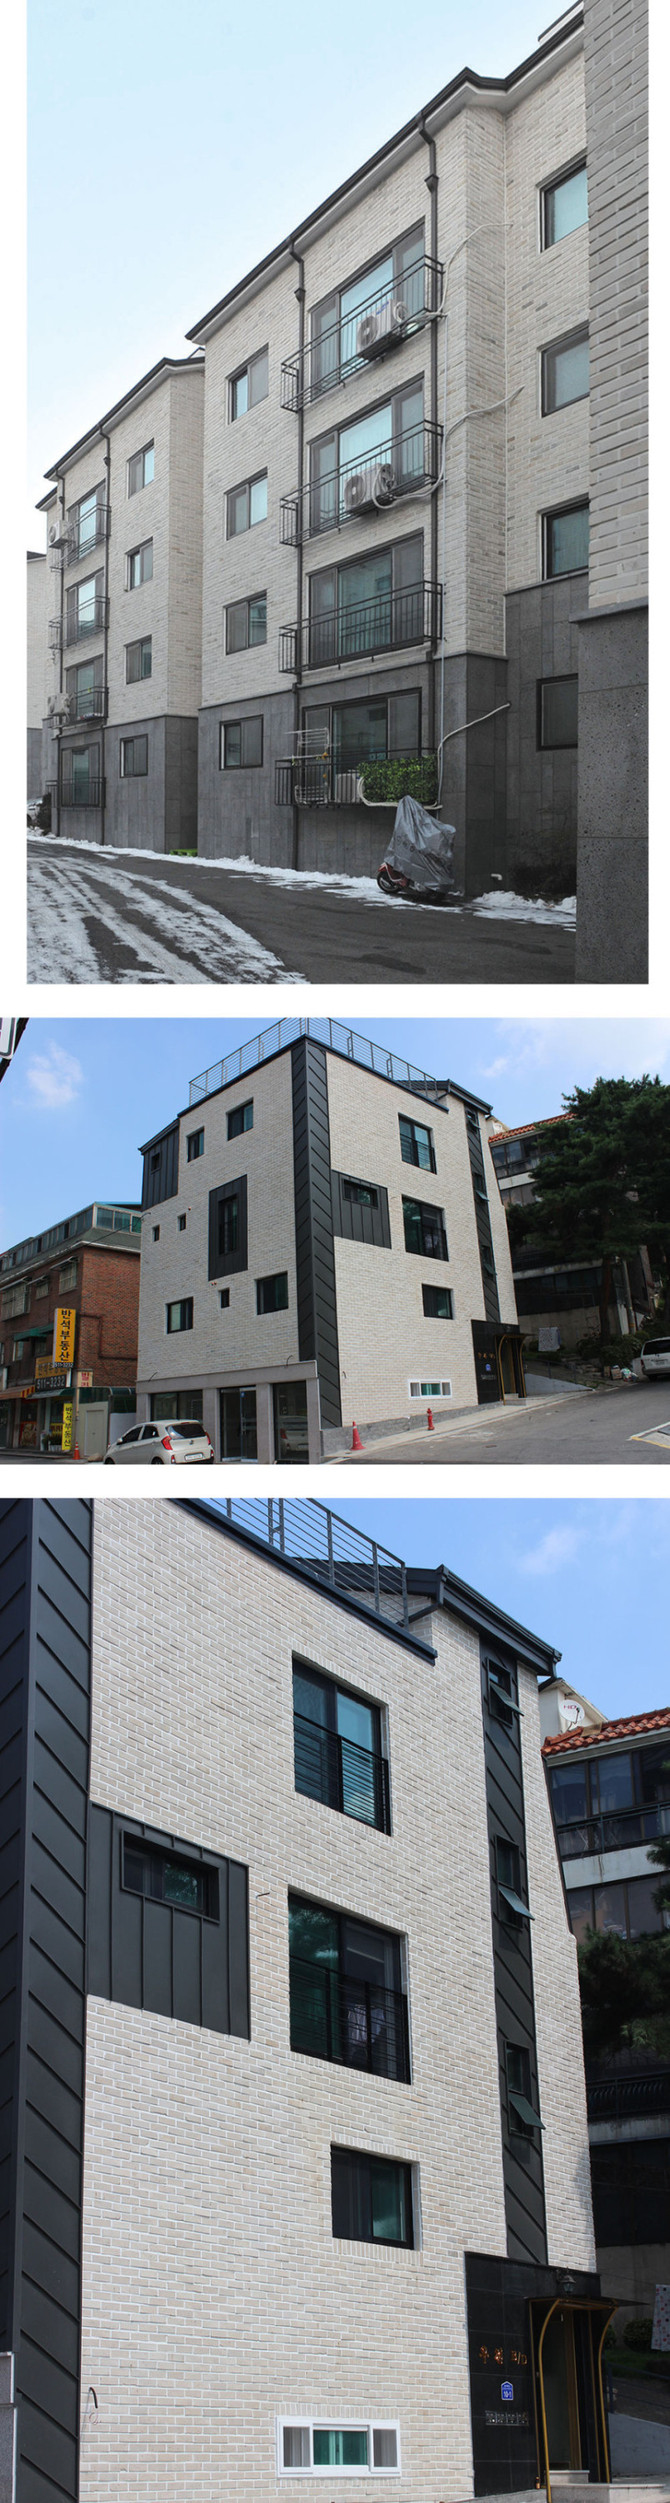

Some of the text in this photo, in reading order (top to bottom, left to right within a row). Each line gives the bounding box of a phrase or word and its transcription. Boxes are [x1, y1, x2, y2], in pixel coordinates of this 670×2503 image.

[59, 1309, 72, 1362] 반석부동산
[37, 1376, 65, 1389] 511-3232
[65, 1407, 73, 1446] 반석부동산
